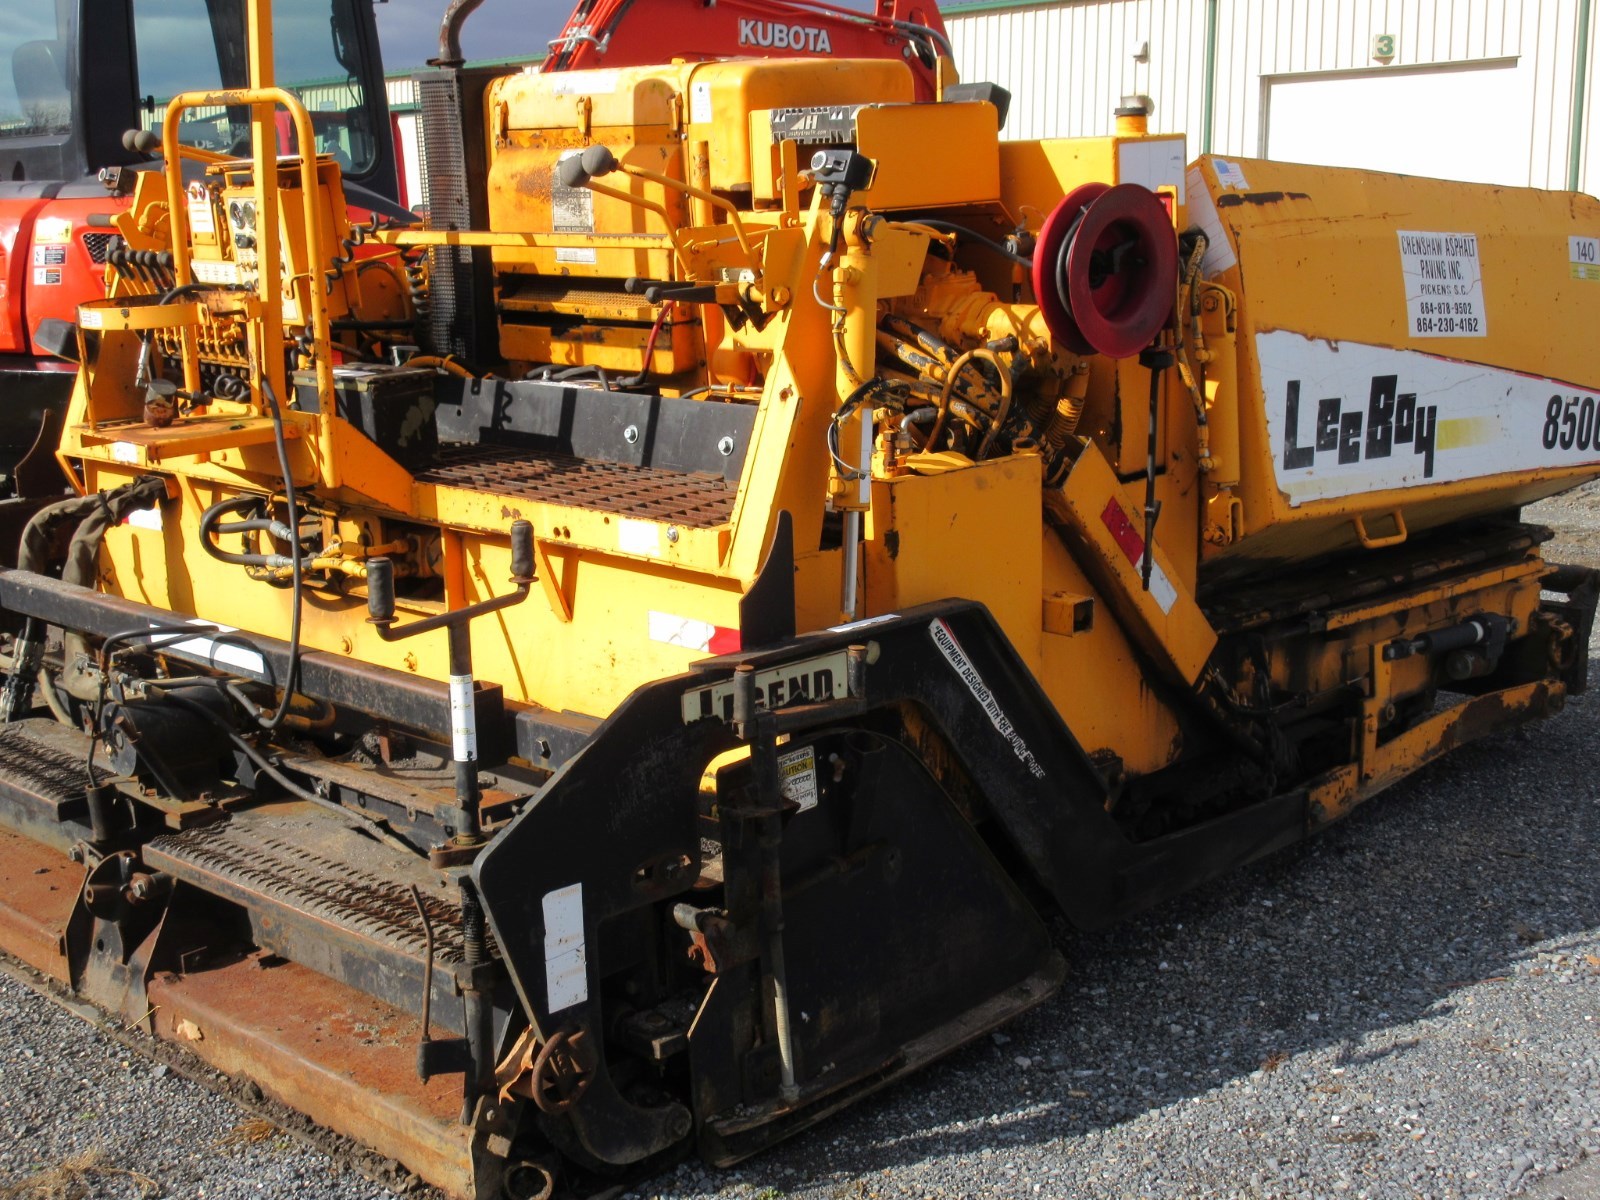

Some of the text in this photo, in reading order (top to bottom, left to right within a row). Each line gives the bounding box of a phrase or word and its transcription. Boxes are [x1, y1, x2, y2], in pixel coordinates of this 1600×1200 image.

[739, 18, 833, 54] KUBOTA
[1377, 35, 1394, 56] 3
[1445, 238, 1475, 257] ASPHALT
[1576, 241, 1595, 262] 140
[1420, 260, 1464, 280] PAVING INC.
[1420, 284, 1452, 296] PICKENS
[1420, 302, 1473, 315] 864-878-9502
[1416, 317, 1479, 333] 864-230-4162
[962, 665, 990, 703] DESIGNED
[984, 697, 1001, 721] WITH
